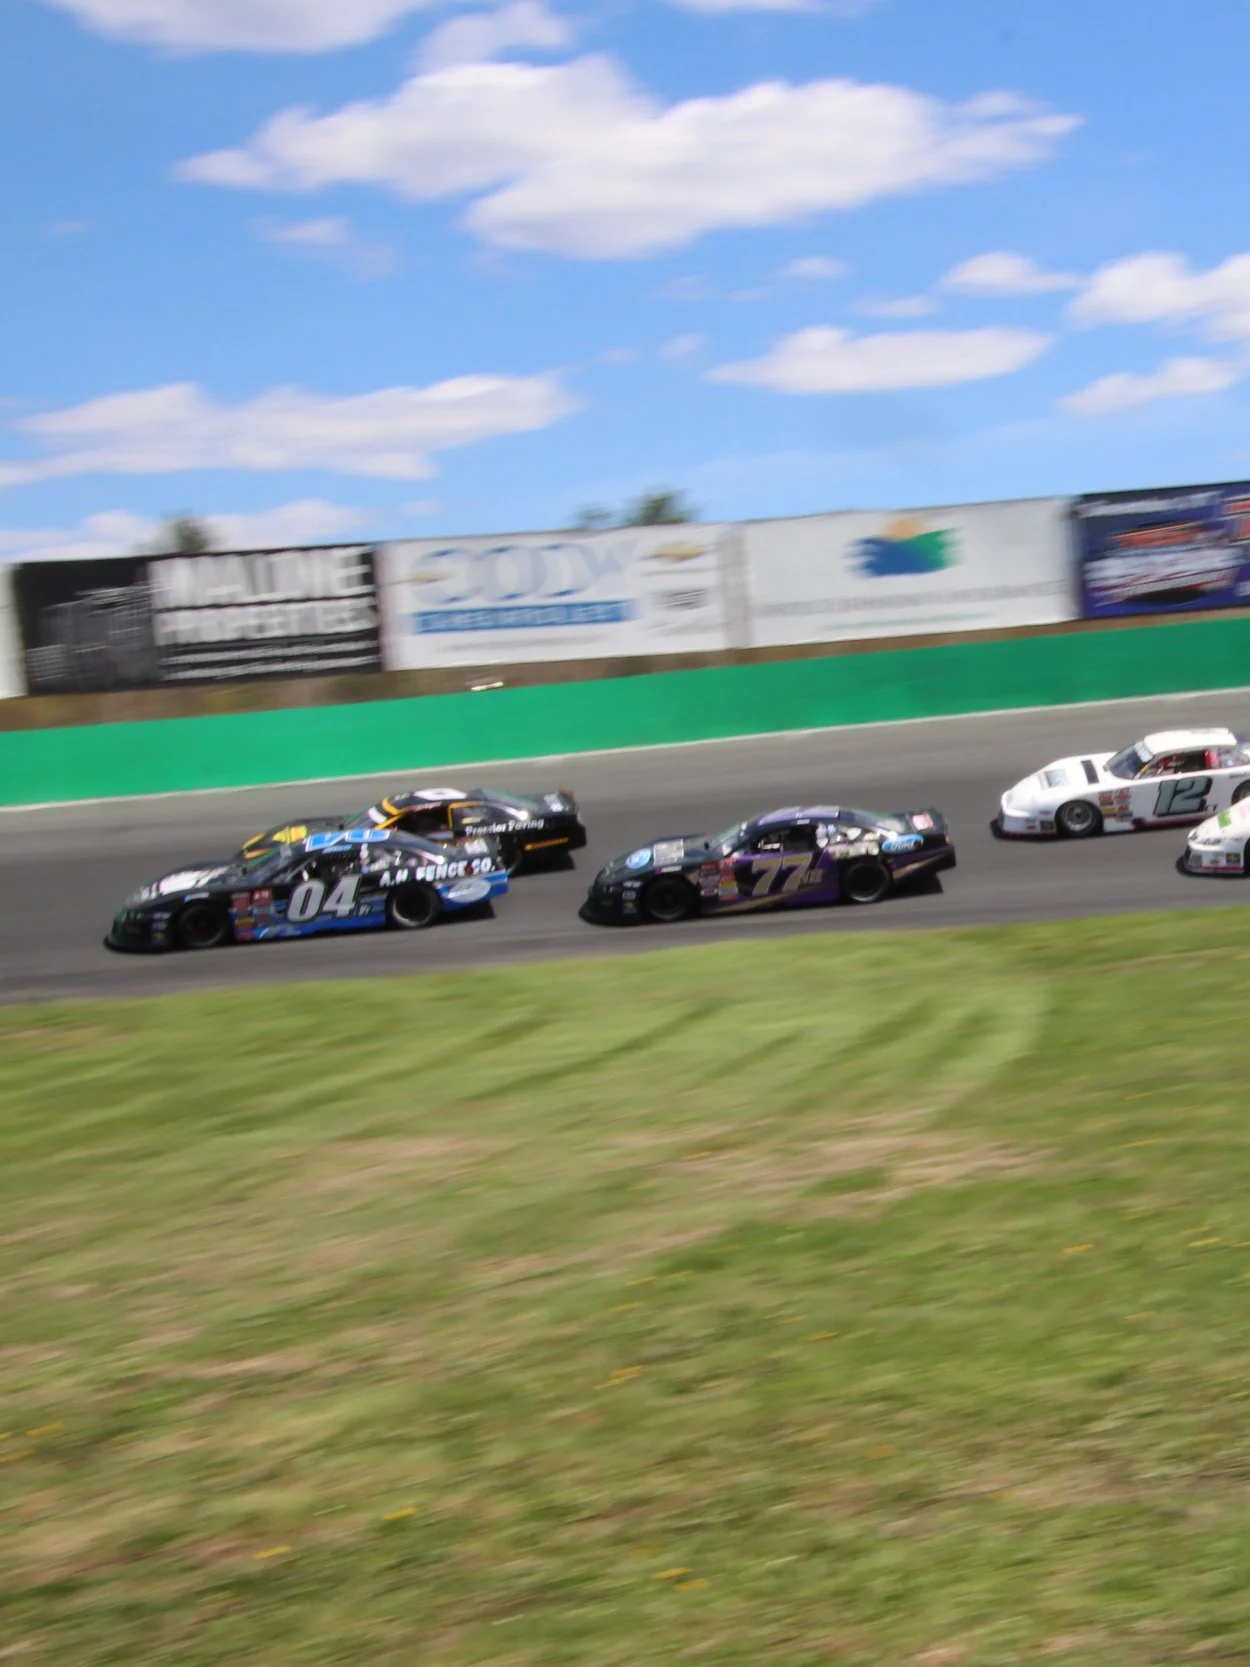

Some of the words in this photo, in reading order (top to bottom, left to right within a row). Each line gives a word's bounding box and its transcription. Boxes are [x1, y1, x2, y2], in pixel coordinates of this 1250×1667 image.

[1153, 776, 1213, 817] 12
[507, 818, 545, 832] Paving
[415, 860, 469, 882] FENCE
[469, 856, 496, 876] CO.
[752, 852, 813, 897] 77
[288, 874, 360, 922] 04
